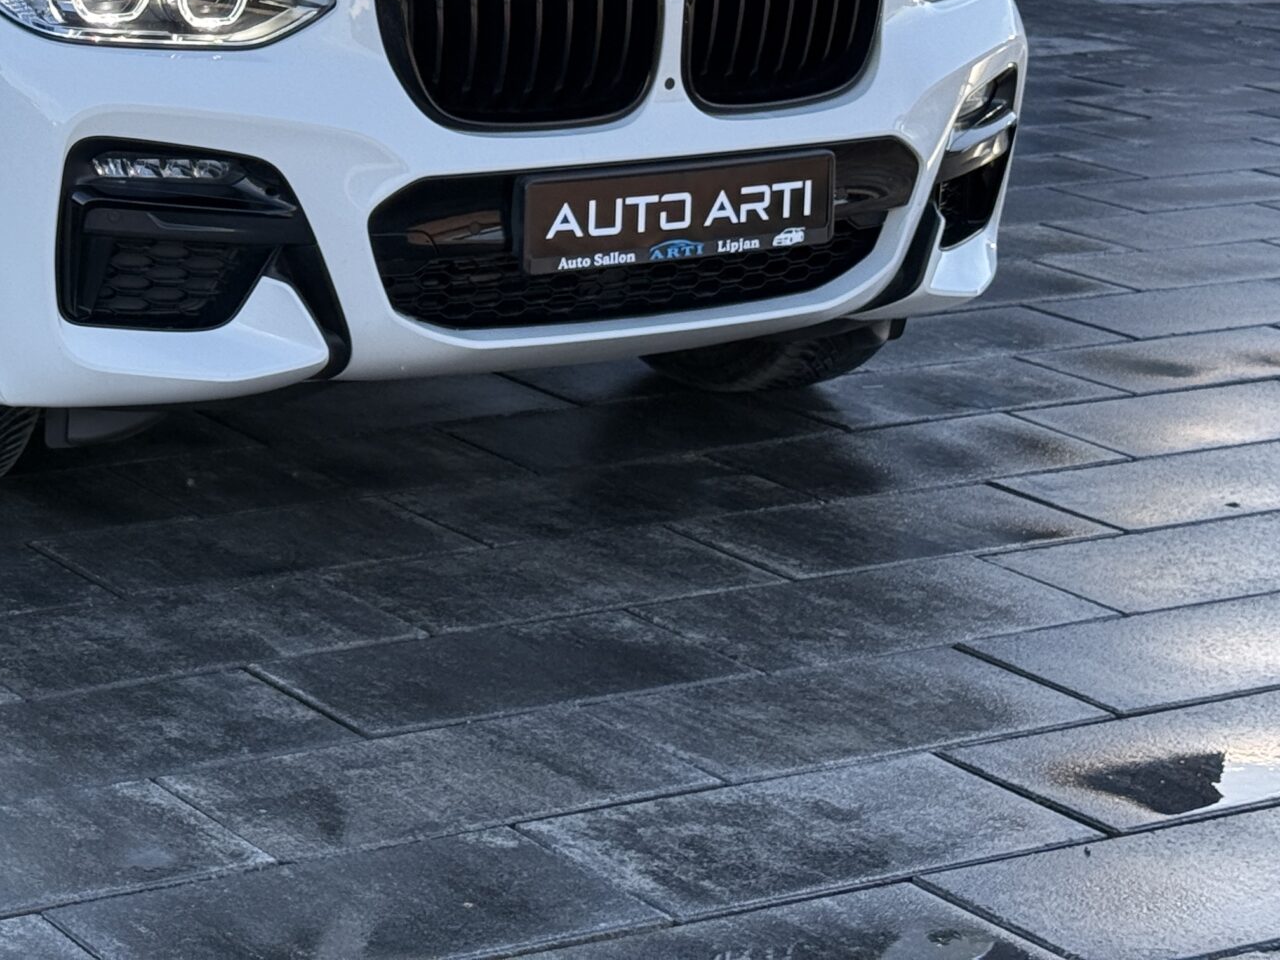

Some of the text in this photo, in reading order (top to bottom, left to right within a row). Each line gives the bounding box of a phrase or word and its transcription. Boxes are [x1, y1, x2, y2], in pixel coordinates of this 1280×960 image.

[545, 180, 813, 239] AUTO ARTI
[558, 238, 760, 270] Auto Sallon ARTI Lipjan
